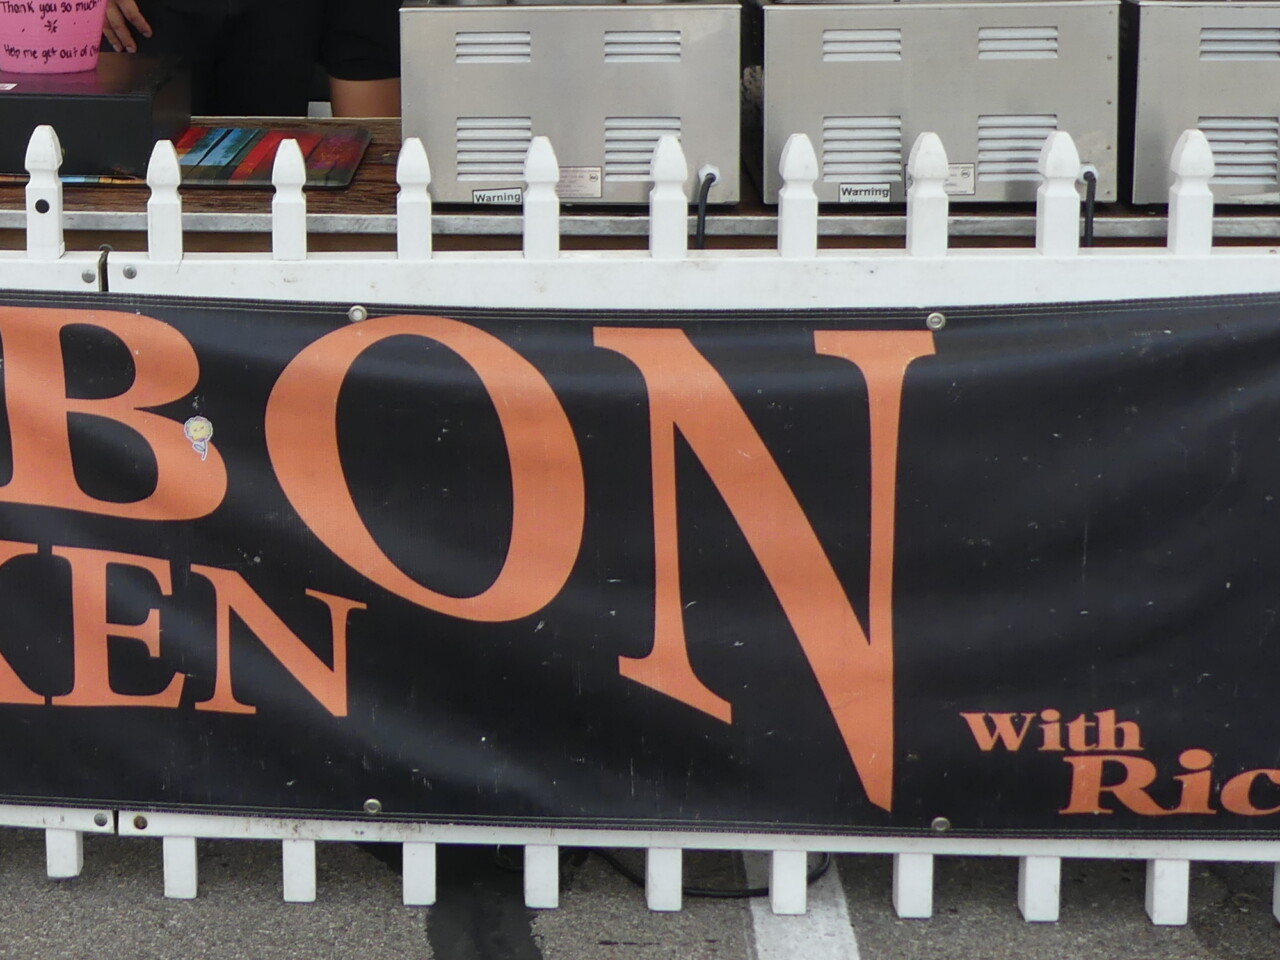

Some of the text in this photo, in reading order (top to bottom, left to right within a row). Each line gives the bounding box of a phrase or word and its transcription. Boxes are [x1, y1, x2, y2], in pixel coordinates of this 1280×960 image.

[39, 1, 57, 19] you
[60, 2, 72, 13] so
[4, 44, 21, 59] Help
[23, 47, 38, 59] me
[41, 46, 57, 64] get
[60, 47, 78, 58] out
[80, 44, 88, 57] of
[475, 193, 521, 203] Warning
[841, 187, 889, 198] Warning
[959, 708, 1144, 751] With
